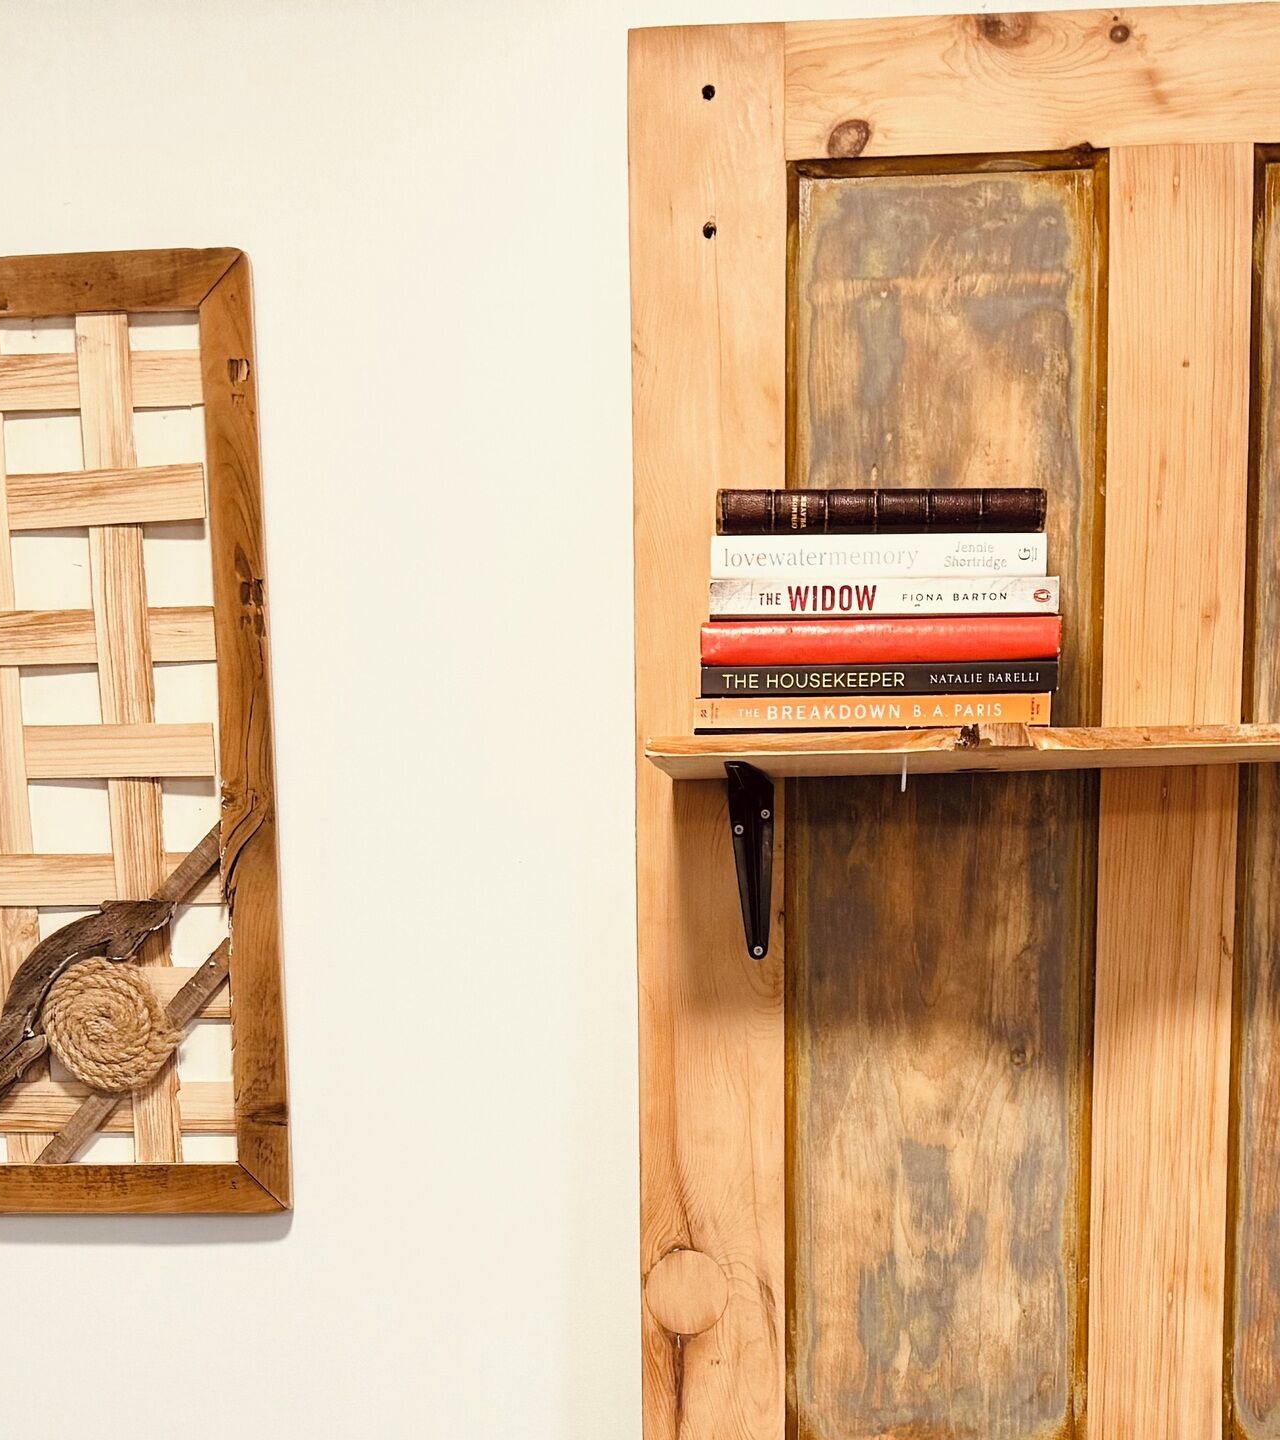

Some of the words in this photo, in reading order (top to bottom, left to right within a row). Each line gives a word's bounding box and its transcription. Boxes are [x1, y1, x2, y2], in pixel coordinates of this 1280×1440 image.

[955, 541, 995, 553] Jennie
[724, 548, 919, 569] lovewatermemory
[943, 556, 1008, 570] Shortridge
[759, 592, 782, 605] THE
[787, 584, 877, 611] WIDOW
[902, 593, 943, 601] FIONA
[953, 592, 1007, 601] BARTON
[722, 673, 759, 689] THE
[766, 672, 905, 689] HOUSEKEEPER
[929, 673, 982, 684] NATALIE
[988, 672, 1039, 683] BARELLI
[738, 708, 760, 718] THE
[767, 704, 901, 720] BREAKDOWN
[954, 703, 1002, 717] PARIS
